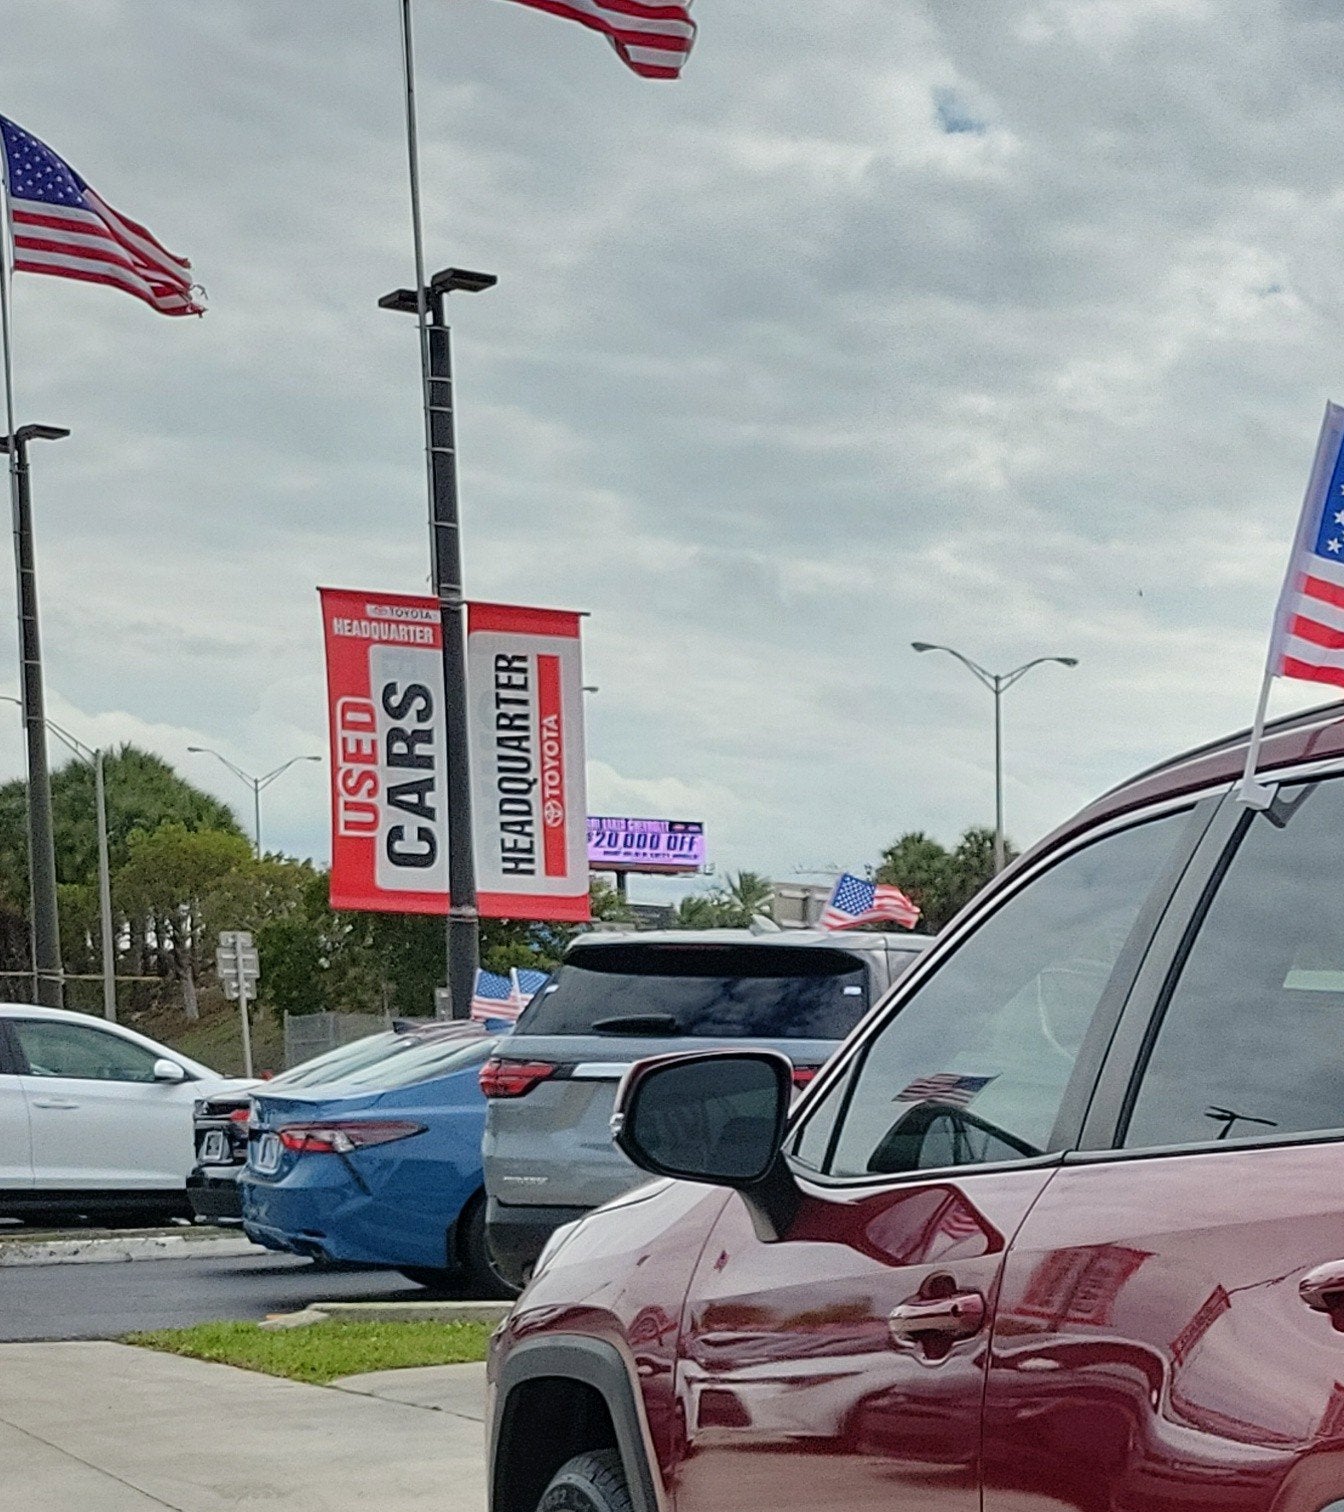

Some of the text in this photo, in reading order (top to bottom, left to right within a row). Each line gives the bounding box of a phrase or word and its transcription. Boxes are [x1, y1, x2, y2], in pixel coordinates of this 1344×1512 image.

[333, 617, 434, 644] HEADQUARTER
[390, 606, 432, 620] TOYOTA
[341, 700, 380, 833] USED
[382, 681, 438, 869] CARS
[495, 653, 538, 876] HEADQUARTER
[543, 713, 561, 799] TOYOTA
